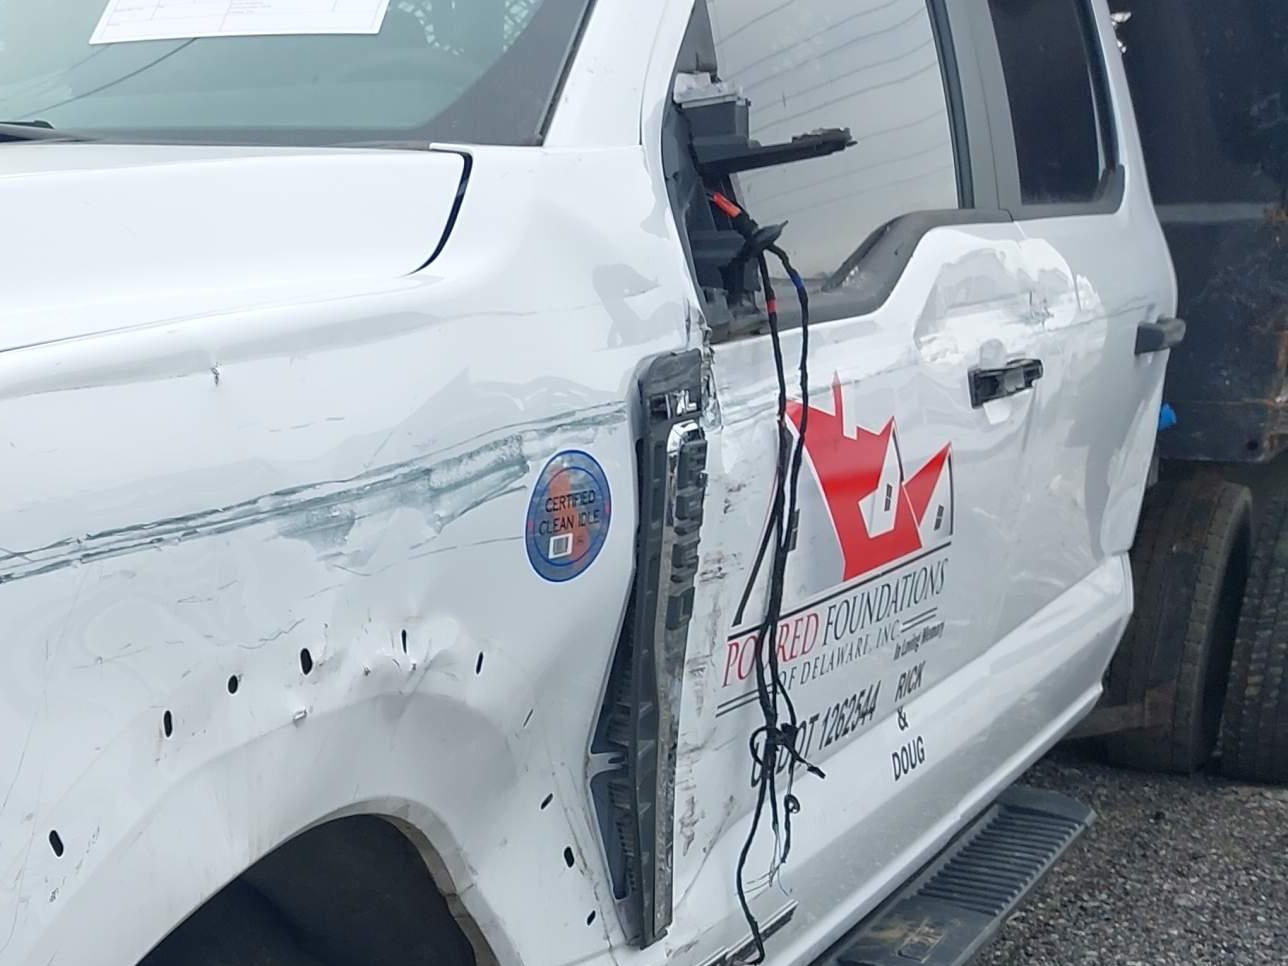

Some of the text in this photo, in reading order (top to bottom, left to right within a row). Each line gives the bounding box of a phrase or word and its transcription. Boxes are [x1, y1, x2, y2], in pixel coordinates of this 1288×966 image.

[539, 509, 600, 535] CLEAN IDLE
[545, 490, 596, 512] CERTIFIED
[722, 558, 948, 688] PORED FOUNDATIONS
[894, 660, 926, 702] RICK
[819, 679, 881, 751] 1262544
[897, 706, 909, 731] &
[892, 735, 925, 781] DOUG
